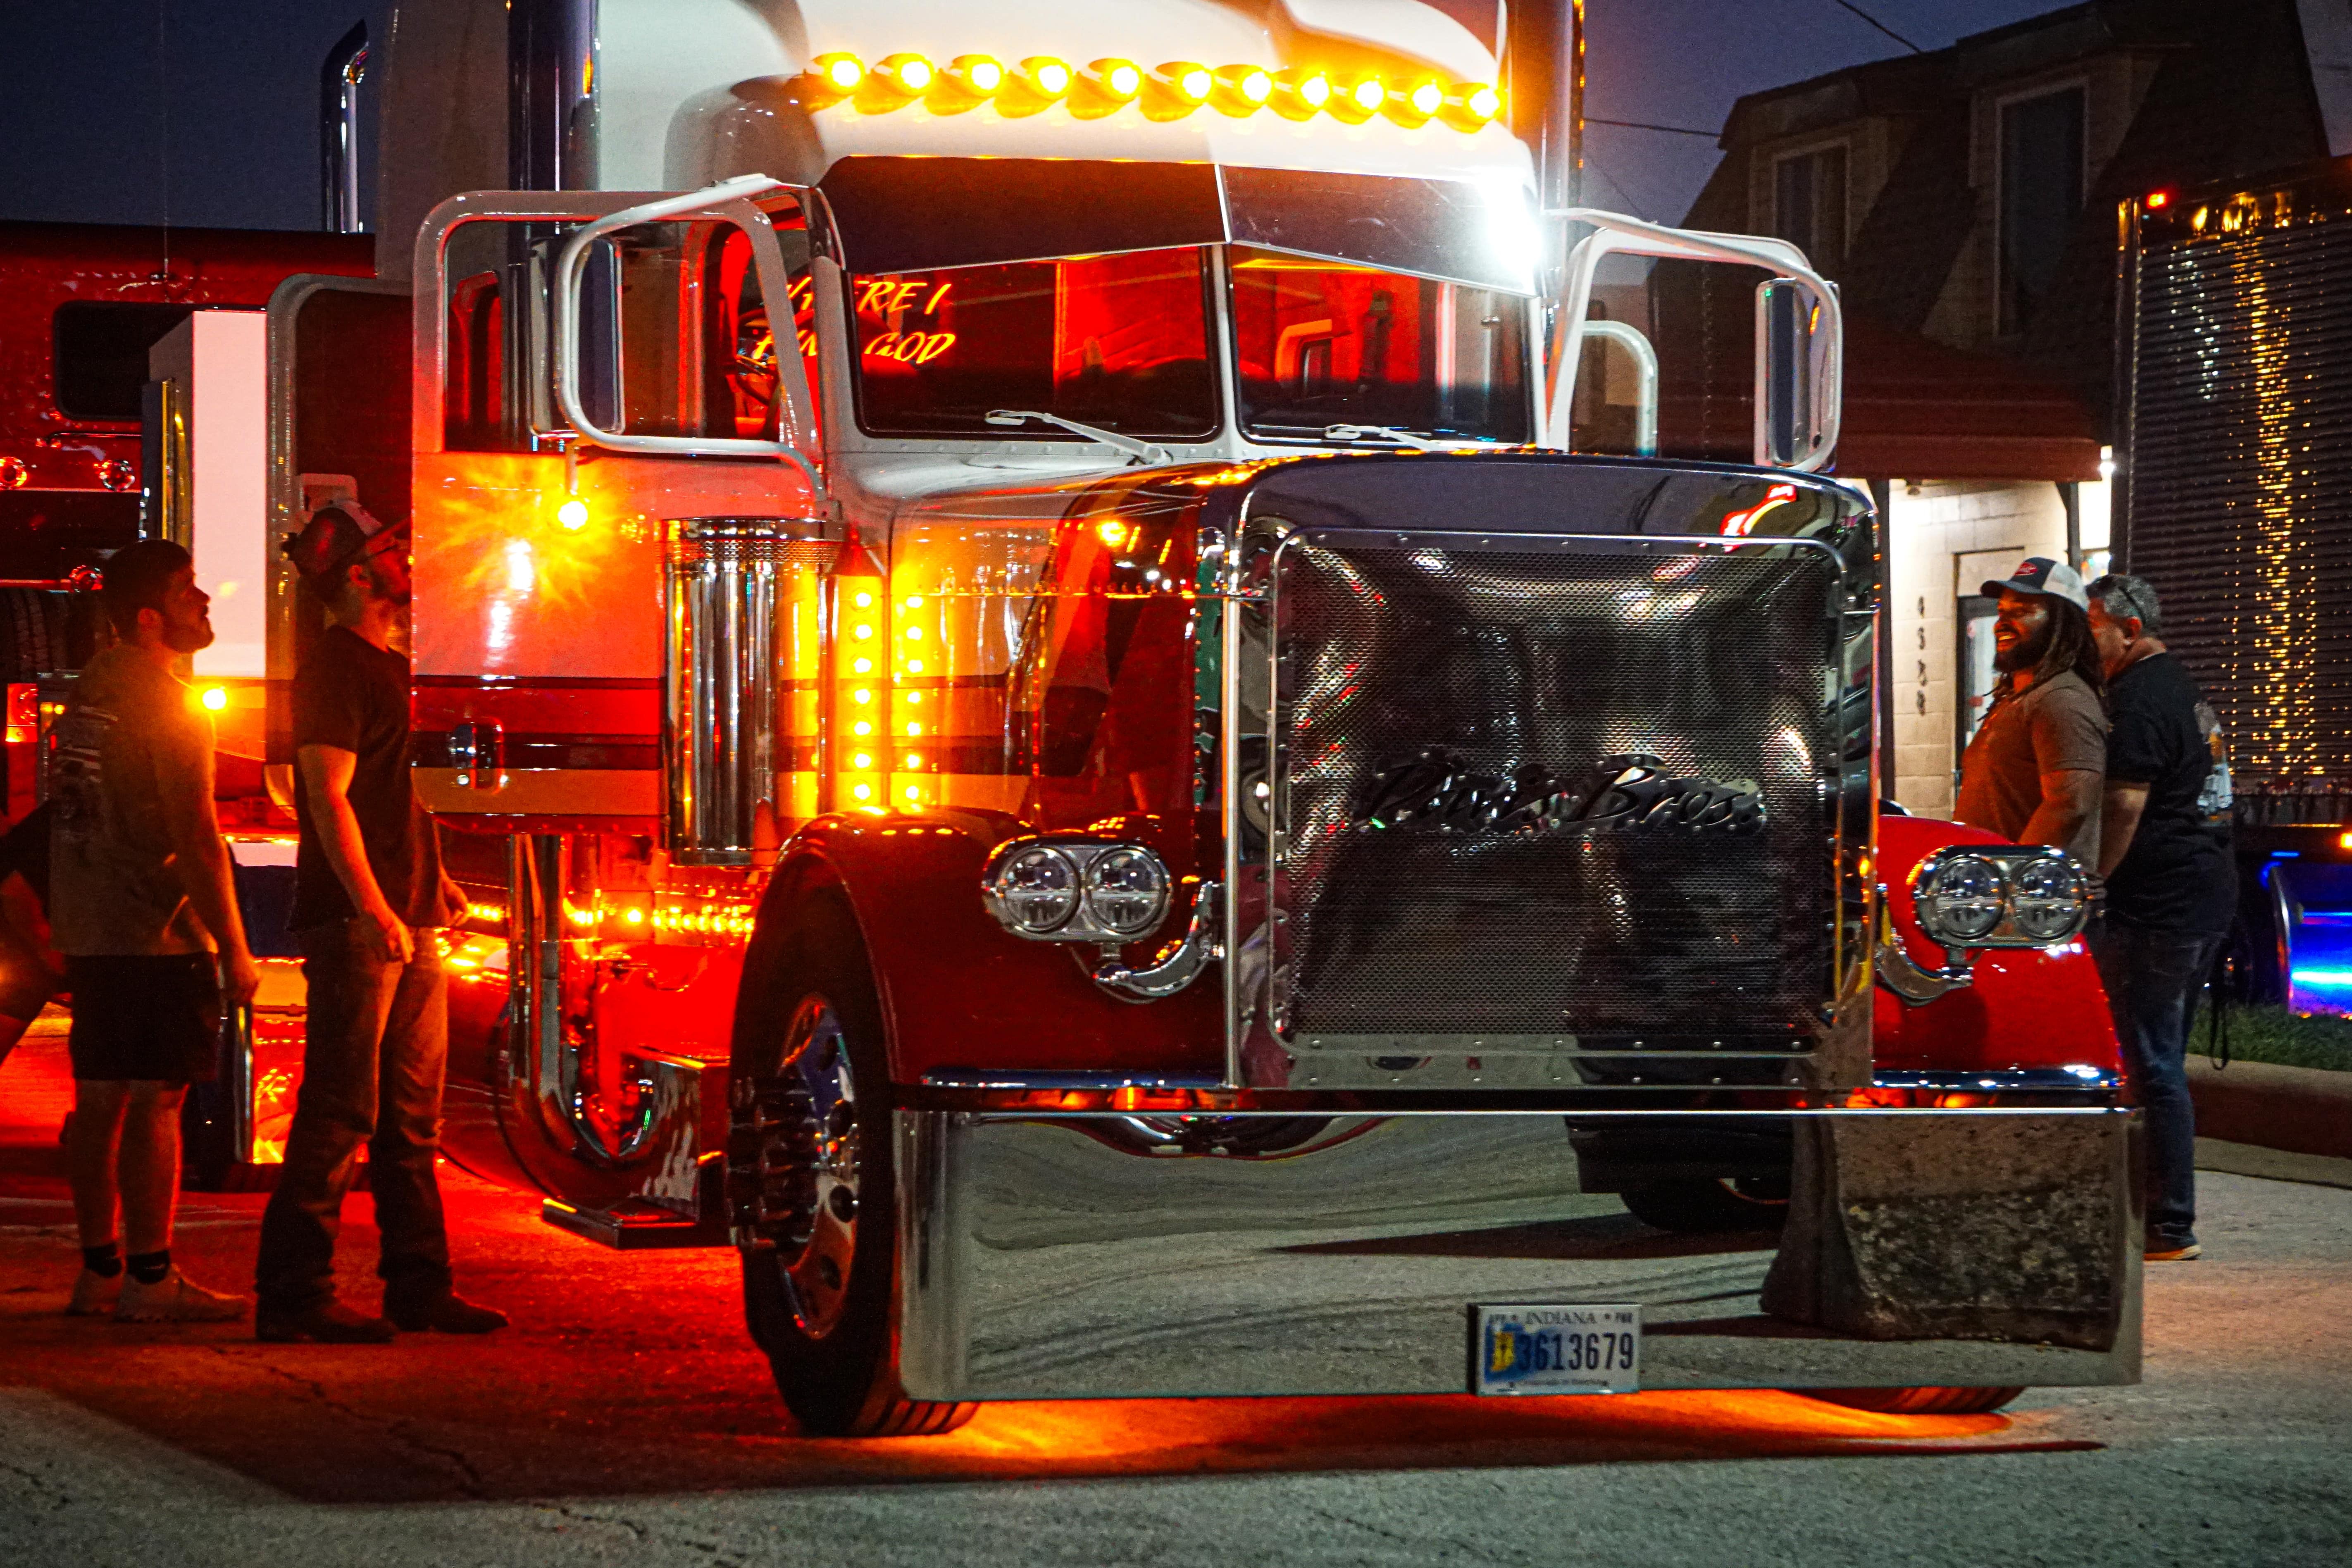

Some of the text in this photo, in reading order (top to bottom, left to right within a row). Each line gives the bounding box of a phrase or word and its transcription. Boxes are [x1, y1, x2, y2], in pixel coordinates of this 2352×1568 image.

[924, 283, 952, 315] I
[864, 331, 956, 365] GOD
[1518, 1332, 1635, 1371] 3613679
